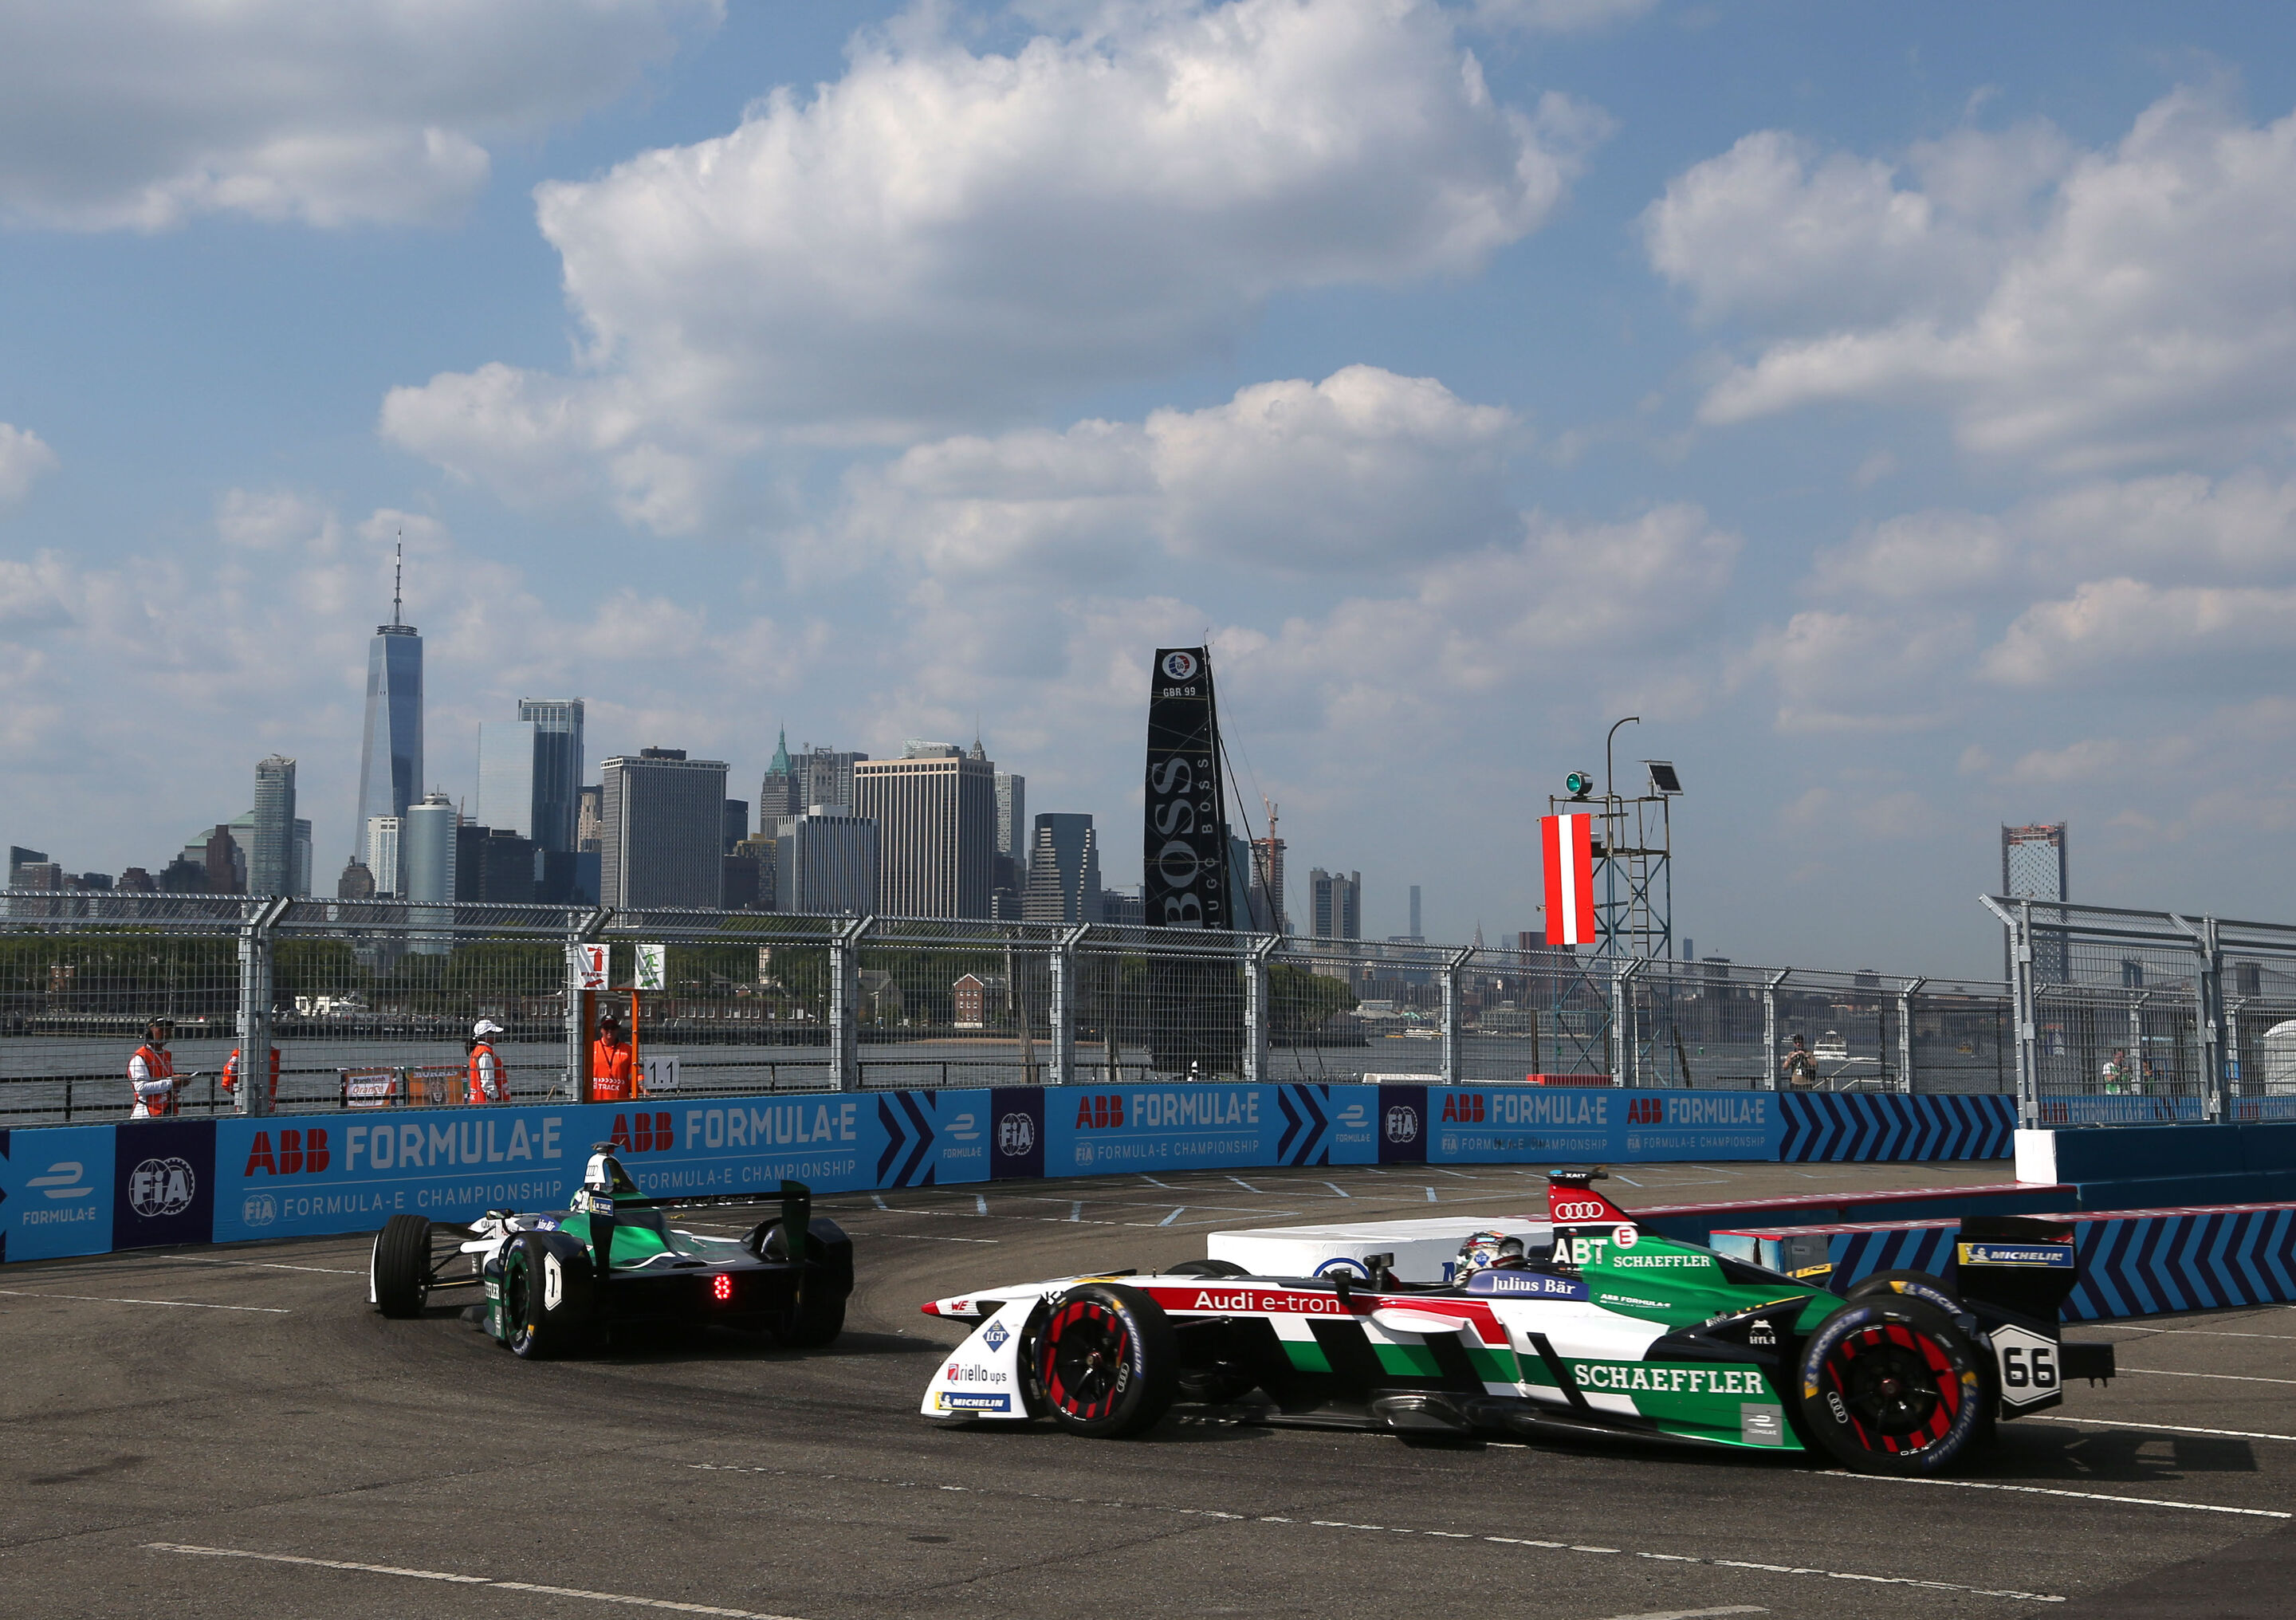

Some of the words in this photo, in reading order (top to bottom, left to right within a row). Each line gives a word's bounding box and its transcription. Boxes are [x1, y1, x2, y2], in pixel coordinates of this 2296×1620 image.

[1163, 688, 1181, 697] GBR
[1185, 686, 1196, 696] 99
[1197, 759, 1213, 834] BOSS
[1152, 757, 1204, 930] BOSS
[650, 1061, 673, 1084] 1.1
[352, 1085, 383, 1095] Orange
[1075, 1095, 1124, 1129] ABB
[1132, 1092, 1260, 1127] FORMULA-E
[1441, 1094, 1485, 1123] ABB
[1492, 1095, 1607, 1124] FORMULA-E
[1627, 1099, 1662, 1124] ABB
[1669, 1098, 1765, 1123] FORMULA-E
[608, 1112, 674, 1154] ABB
[686, 1103, 856, 1149] FORMULA-E
[244, 1128, 330, 1176] ABB
[346, 1117, 562, 1170] FORMULA-E
[1098, 1143, 1168, 1160] FORMULA-E
[1174, 1139, 1260, 1155] CHAMPIONSHIP
[1461, 1138, 1523, 1150] FORMULA-E
[1531, 1138, 1607, 1150] CHAMPIONSHIP
[1644, 1137, 1695, 1148] FORMULA-E
[1700, 1136, 1765, 1148] CHAMPIONSHIP
[639, 1168, 732, 1190] FORMULA-E
[742, 1160, 855, 1182] CHAMPIONSHIP
[284, 1191, 405, 1217] FORMULA-E
[418, 1181, 562, 1207] CHAMPIONSHIP
[684, 1194, 714, 1204] Audi
[23, 1207, 96, 1226] FORMULA-E
[1619, 1229, 1632, 1244] E
[1551, 1238, 1608, 1264] ABT
[1991, 1251, 2064, 1261] MICHELIN
[1614, 1256, 1711, 1268] SCHAEFFLER
[1492, 1276, 1539, 1292] Julius
[1544, 1279, 1576, 1295] Bär
[952, 1300, 969, 1311] WE
[1194, 1291, 1254, 1309] Audi
[1262, 1295, 1340, 1312] e-tron
[1601, 1293, 1619, 1302] ABB
[986, 1331, 1006, 1342] LGT
[960, 1364, 988, 1381] riello
[989, 1373, 1007, 1384] ups
[2003, 1347, 2056, 1388] 66
[1575, 1364, 1764, 1394] SCHAEFFLER
